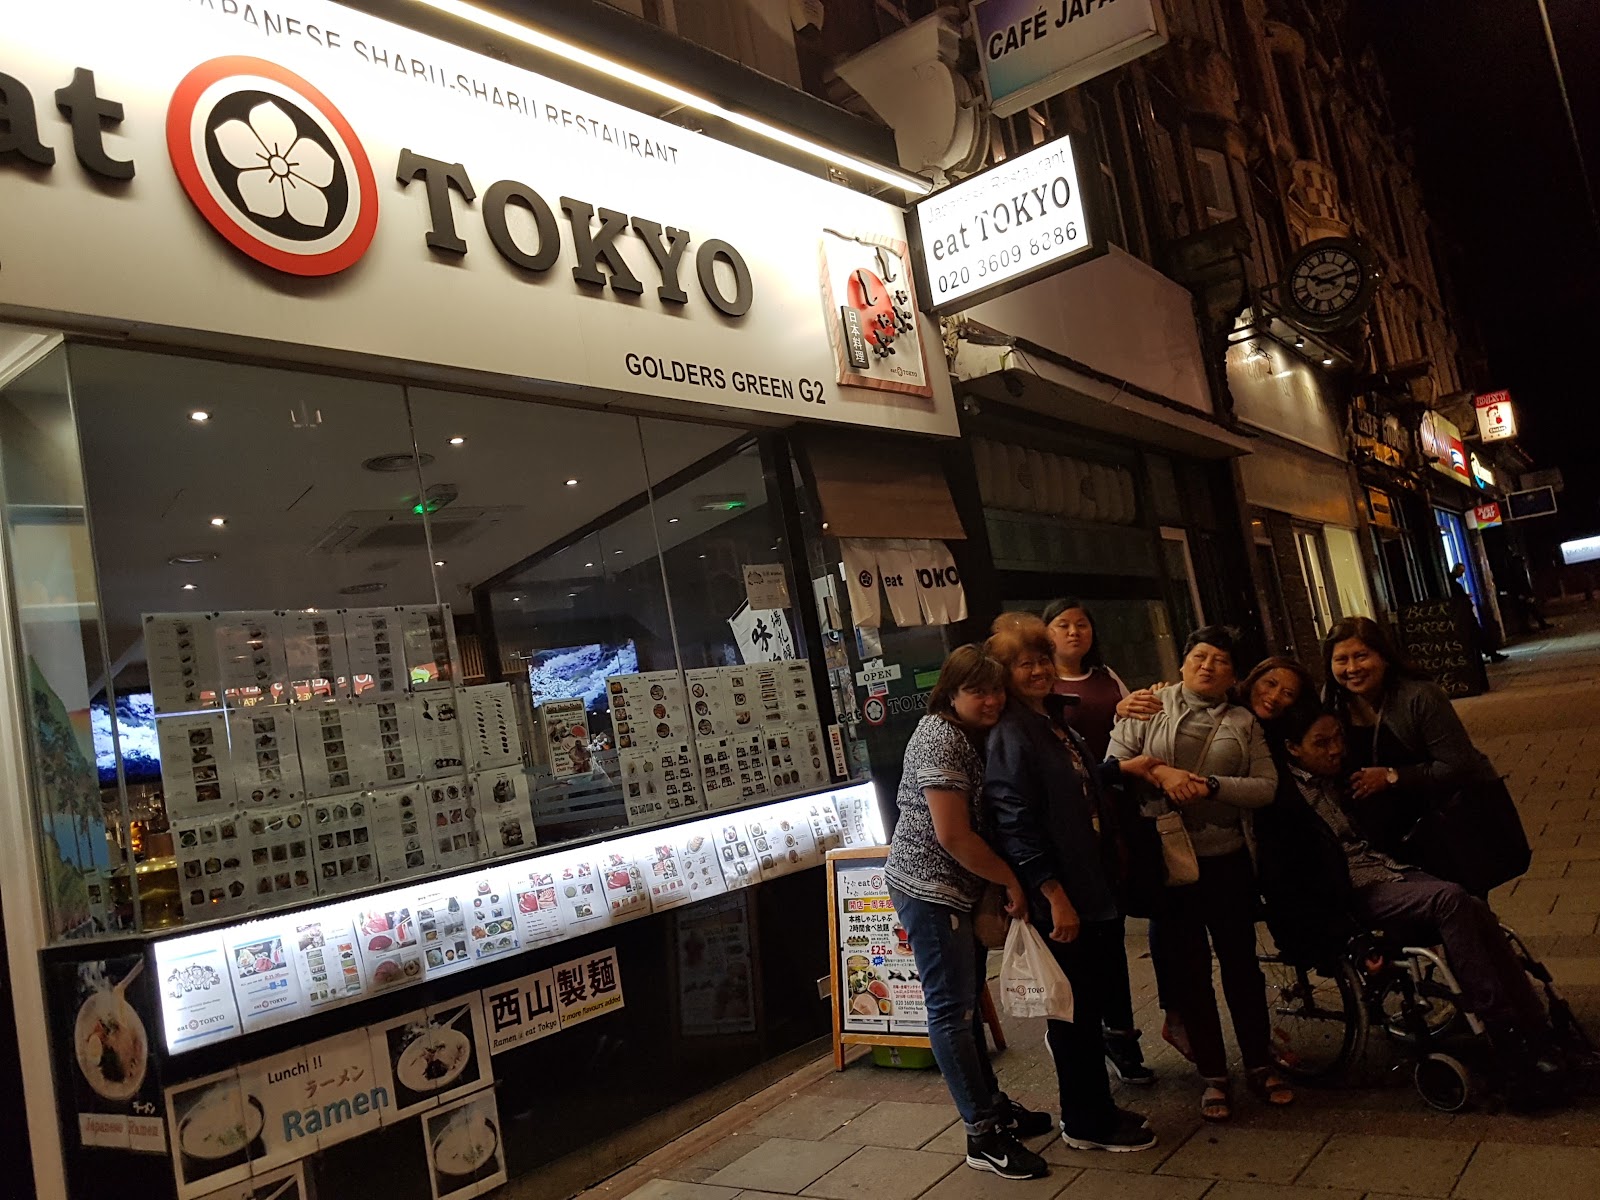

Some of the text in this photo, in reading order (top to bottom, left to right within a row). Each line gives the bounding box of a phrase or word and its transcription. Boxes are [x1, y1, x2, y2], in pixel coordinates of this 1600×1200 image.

[988, 0, 1115, 60] CAFÉ JAP
[545, 103, 678, 164] RESTAURANT
[933, 176, 1070, 260] eat TOKYO
[396, 147, 754, 317] TOKYO
[938, 266, 970, 293] 020
[978, 244, 1022, 277] 3609
[848, 311, 866, 364] 日本料理
[625, 353, 827, 405] GOLDERS GREEN G2
[1477, 505, 1495, 515] JUST
[1482, 511, 1496, 520] EAT
[884, 574, 904, 587] eat
[863, 669, 892, 682] OPEN
[838, 708, 863, 724] eat
[857, 879, 871, 887] eat
[848, 914, 893, 923] 本格しゃぶしゃぶ
[849, 924, 890, 932] 2時間食べ放題
[871, 945, 893, 955] £25.00
[489, 955, 617, 1034] 西山製麺
[561, 994, 621, 1023] 2 more flavours added
[177, 1014, 225, 1032] eat TOKYO
[493, 1033, 518, 1049] Ramen
[525, 1027, 536, 1037] eat
[538, 1020, 557, 1032] Tokyo
[268, 1060, 310, 1084] Lunchi
[305, 1065, 365, 1099] ラーメン
[282, 1086, 389, 1143] Ramen
[128, 1120, 159, 1137] Ramen
